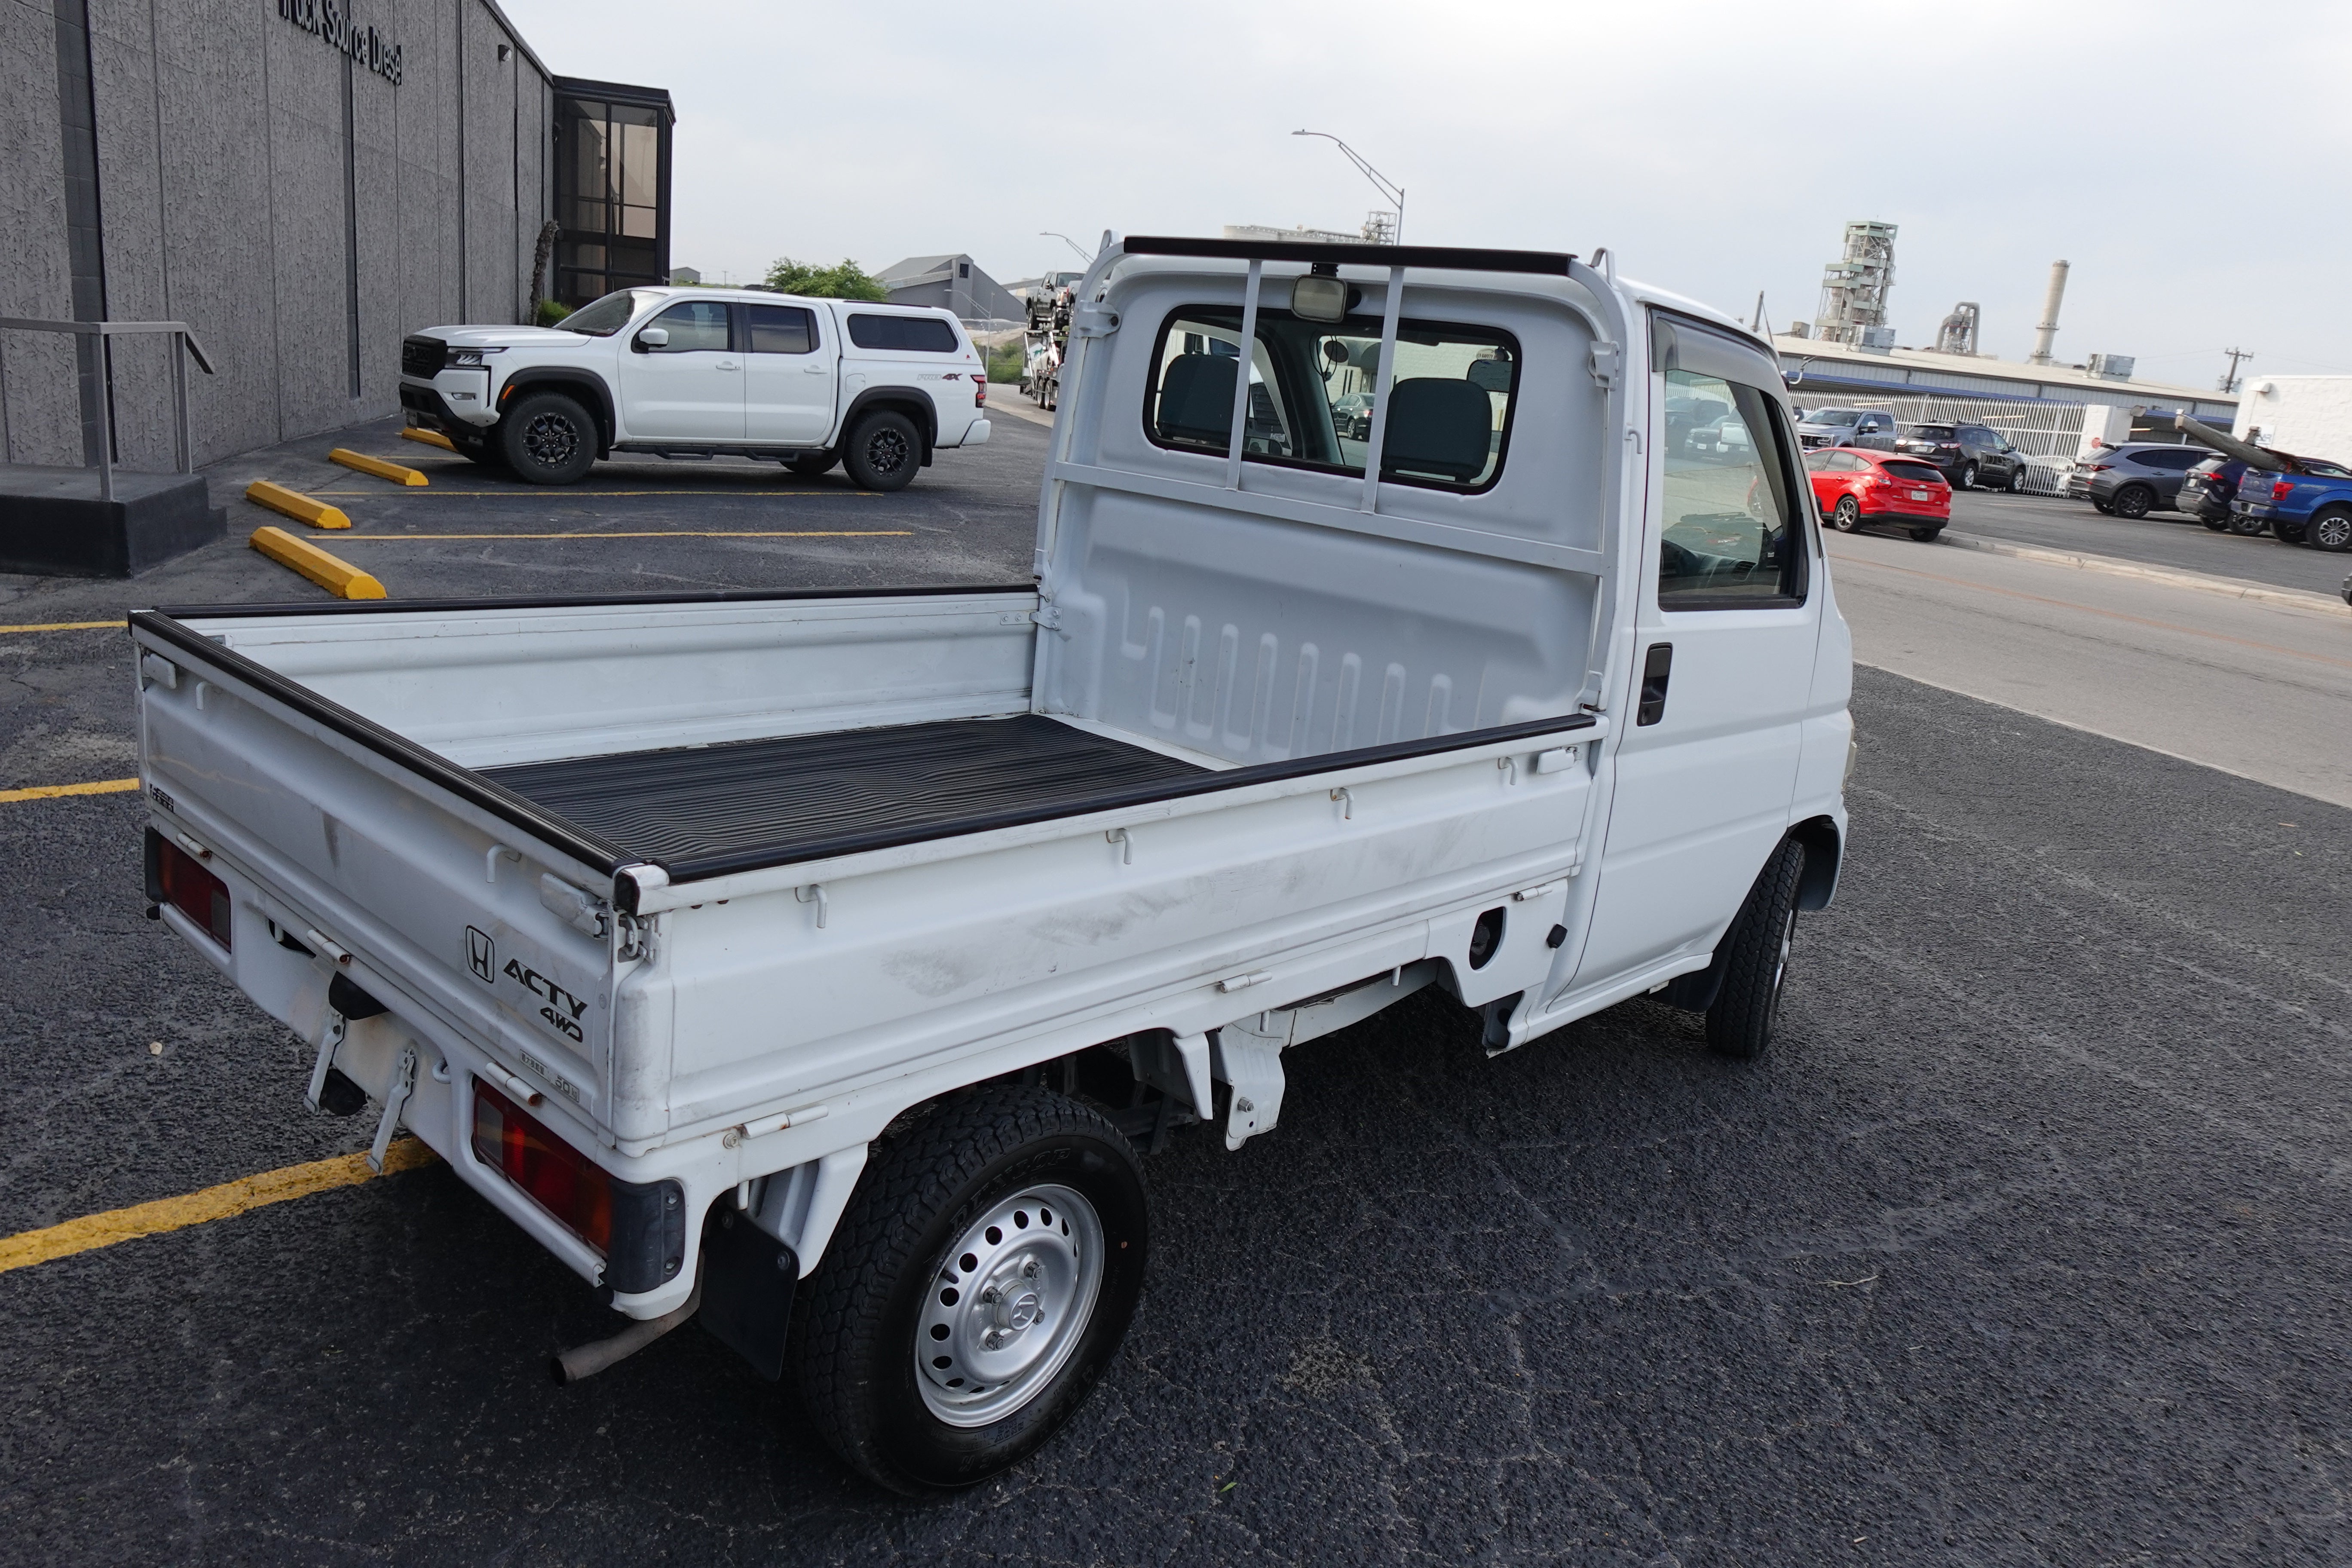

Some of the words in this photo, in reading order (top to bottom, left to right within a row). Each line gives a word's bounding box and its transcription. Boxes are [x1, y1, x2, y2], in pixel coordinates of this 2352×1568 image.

[323, 0, 369, 64] Source
[369, 26, 403, 86] Diesel
[503, 959, 588, 1021] ACTY
[540, 1007, 583, 1043] 4WD
[949, 1147, 1071, 1234] DUNLOP
